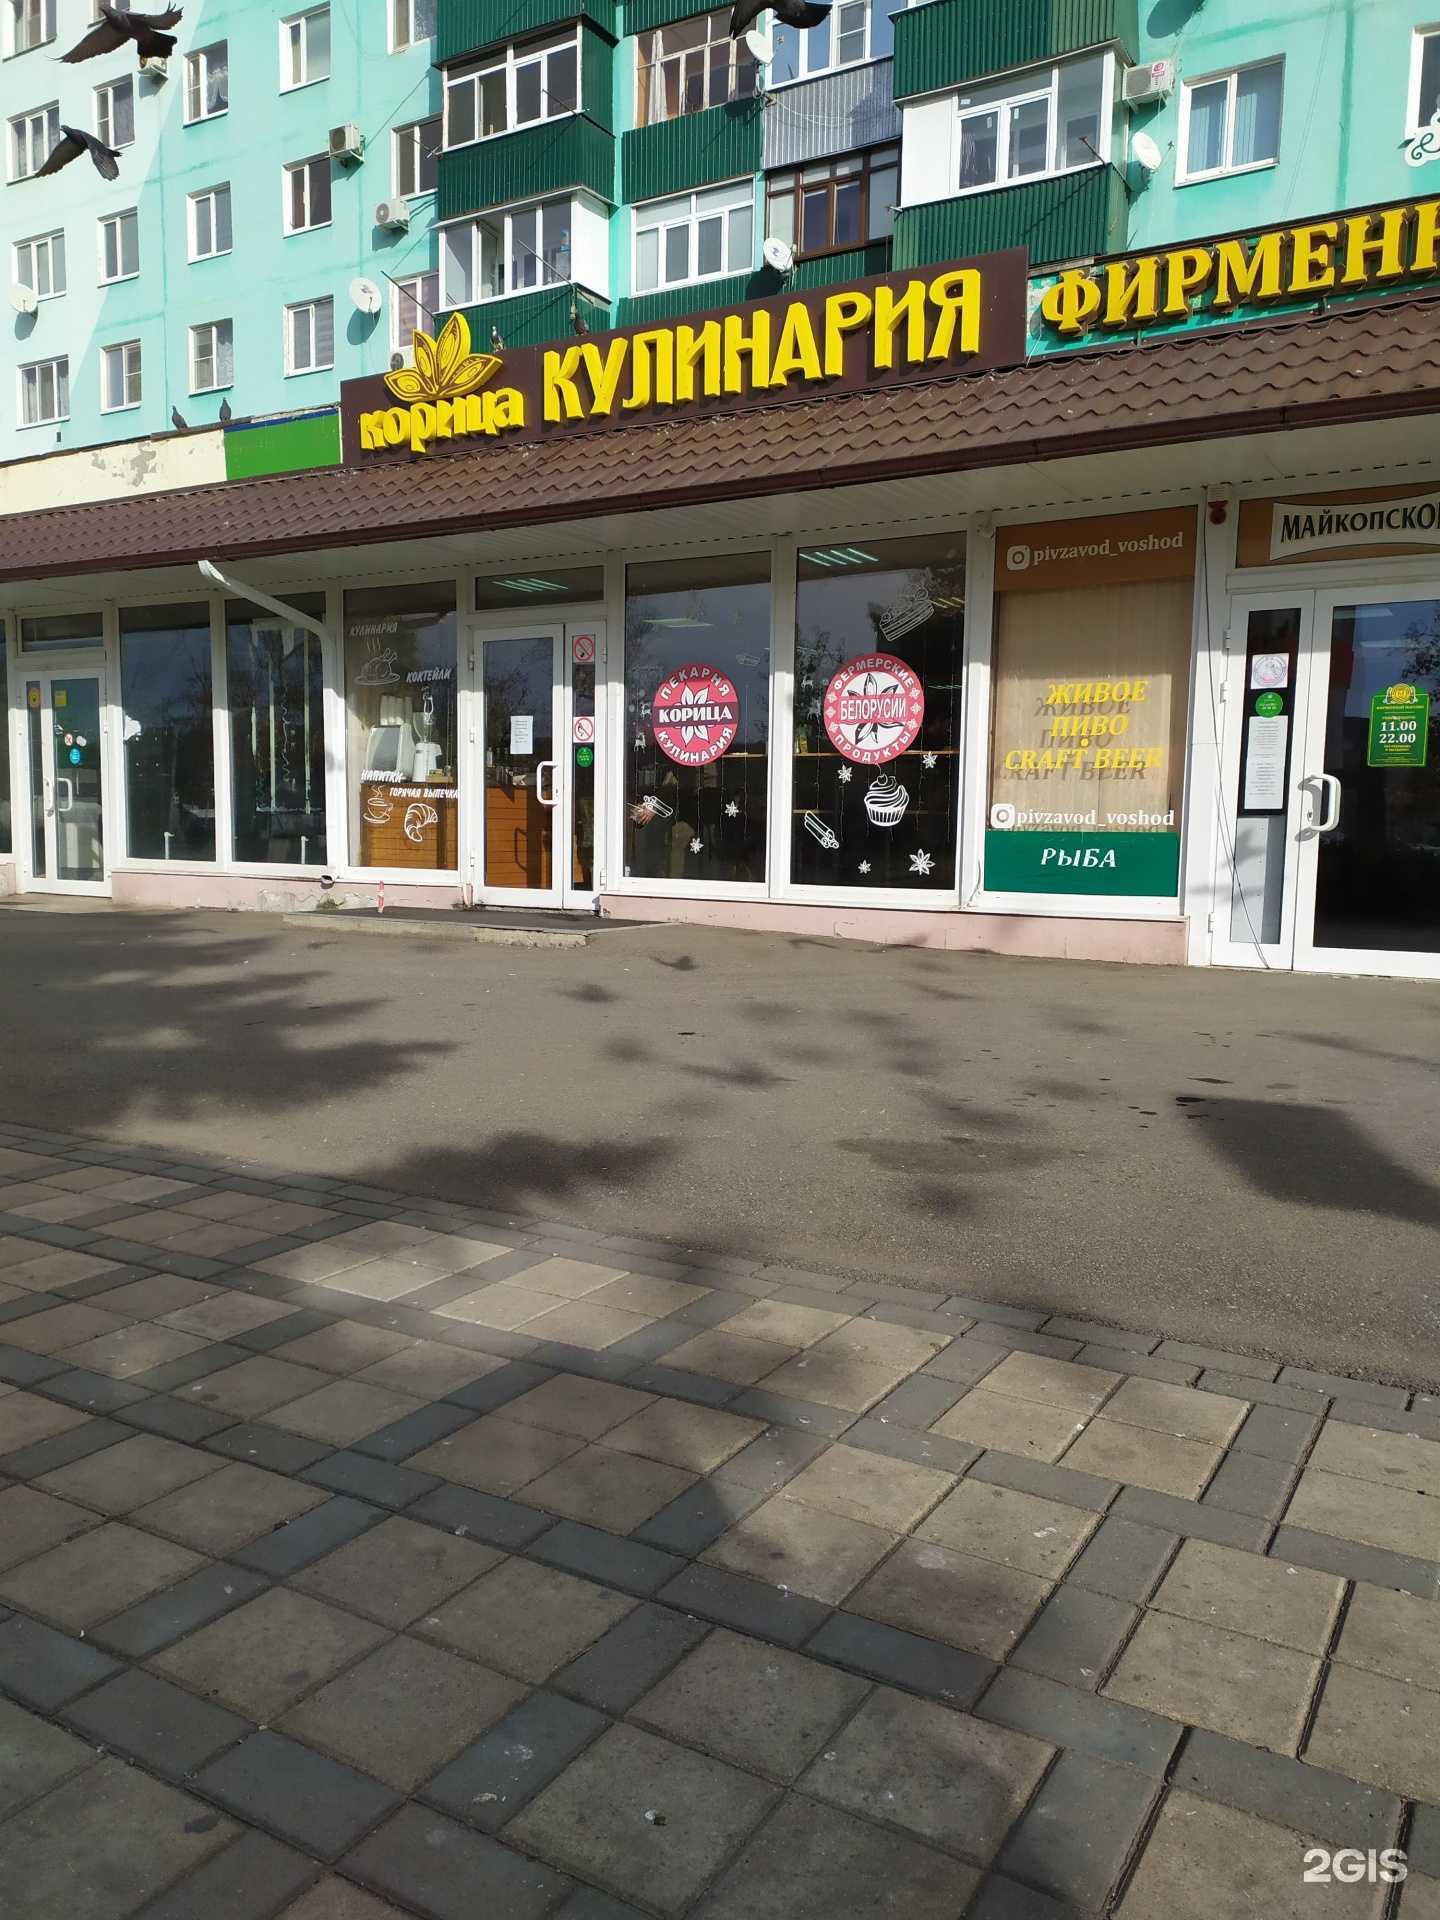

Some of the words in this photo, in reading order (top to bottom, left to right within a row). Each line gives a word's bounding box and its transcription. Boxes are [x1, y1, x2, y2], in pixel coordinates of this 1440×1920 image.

[543, 268, 981, 421] КУЛИНАРИЯ
[360, 387, 525, 453] корица
[1280, 502, 1440, 543] МАЙКОПСКО
[1033, 532, 1183, 566] pivzavod_voshod
[406, 666, 452, 683] КОКТЕЙЛИ
[661, 667, 730, 700] ПЕКАРНЯ
[834, 658, 914, 690] ФЕРМЕРСКИЕ
[1045, 679, 1149, 705] ЖИВОЕ
[659, 705, 733, 723] КОРИЦА
[840, 698, 907, 721] БЕЛОРУСИИ
[1050, 714, 1130, 737] ПИВО
[1380, 720, 1418, 732] 11.00
[658, 727, 733, 763] КУЛИНАРИЯ
[835, 731, 912, 763] ПРОДУКТЫ
[1379, 733, 1417, 744] 22.00
[1005, 749, 1088, 770] CRAFT
[1093, 746, 1166, 769] BEER
[361, 769, 402, 783] НАПИТКИ
[389, 787, 420, 798] ГОРЯЧАЯ
[423, 788, 459, 799] ВЫПЕЧКА
[1016, 808, 1175, 827] pivzavod_voshod
[1040, 847, 1117, 868] РЫБА
